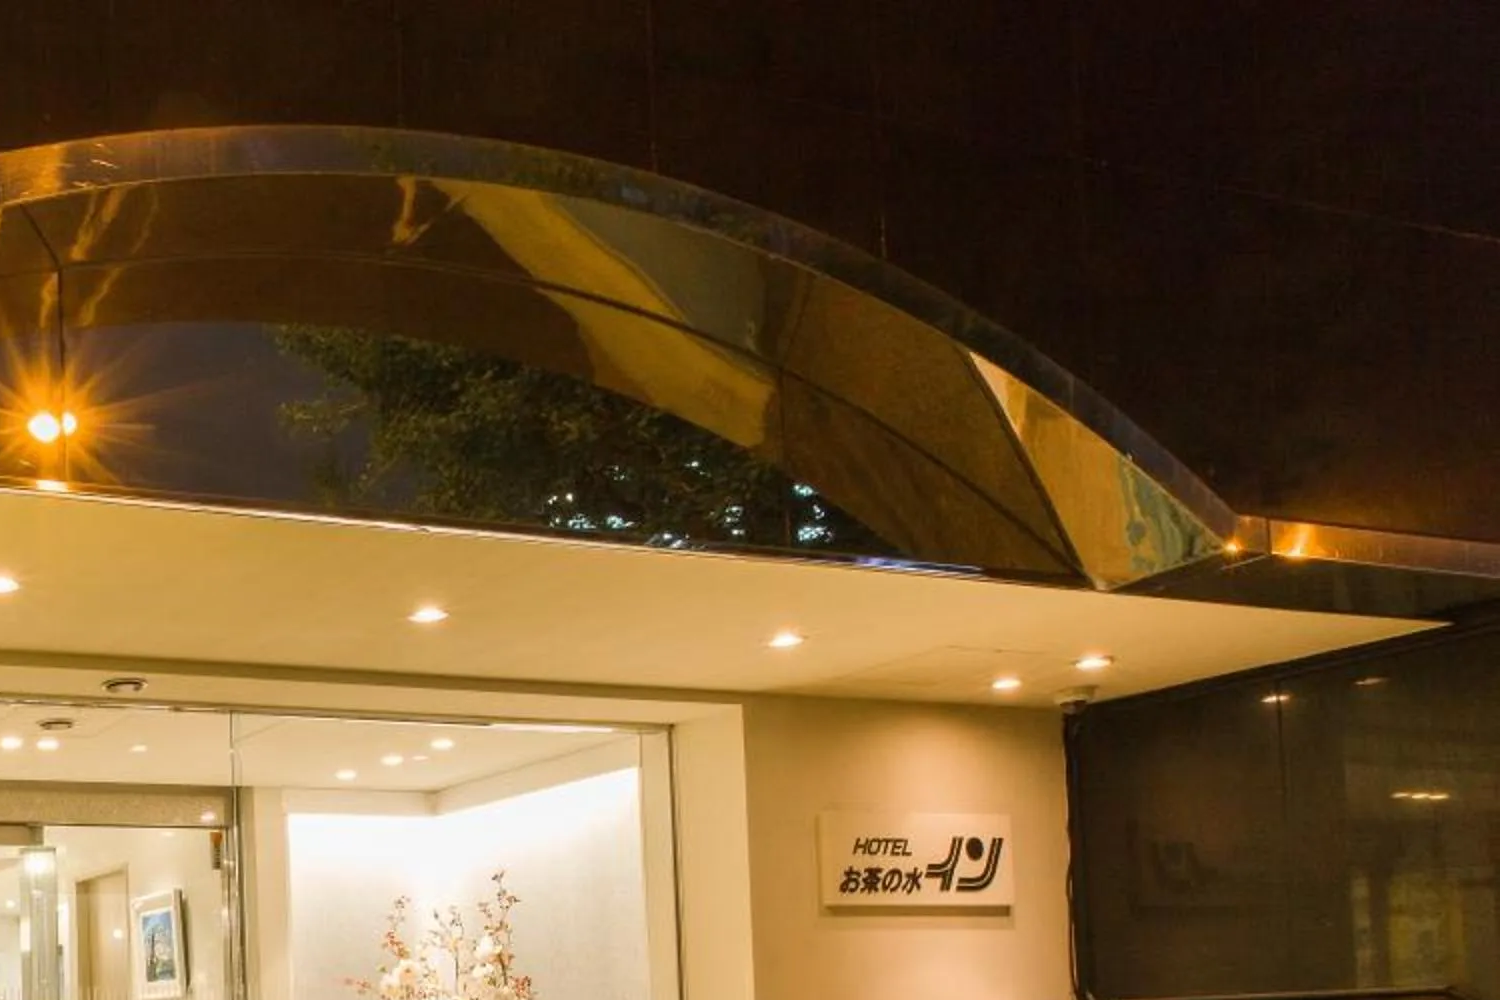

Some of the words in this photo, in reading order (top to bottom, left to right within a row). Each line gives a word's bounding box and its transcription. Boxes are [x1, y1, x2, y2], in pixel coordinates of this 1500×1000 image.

[852, 837, 912, 857] HOTEL
[839, 866, 923, 894] お茶の水
